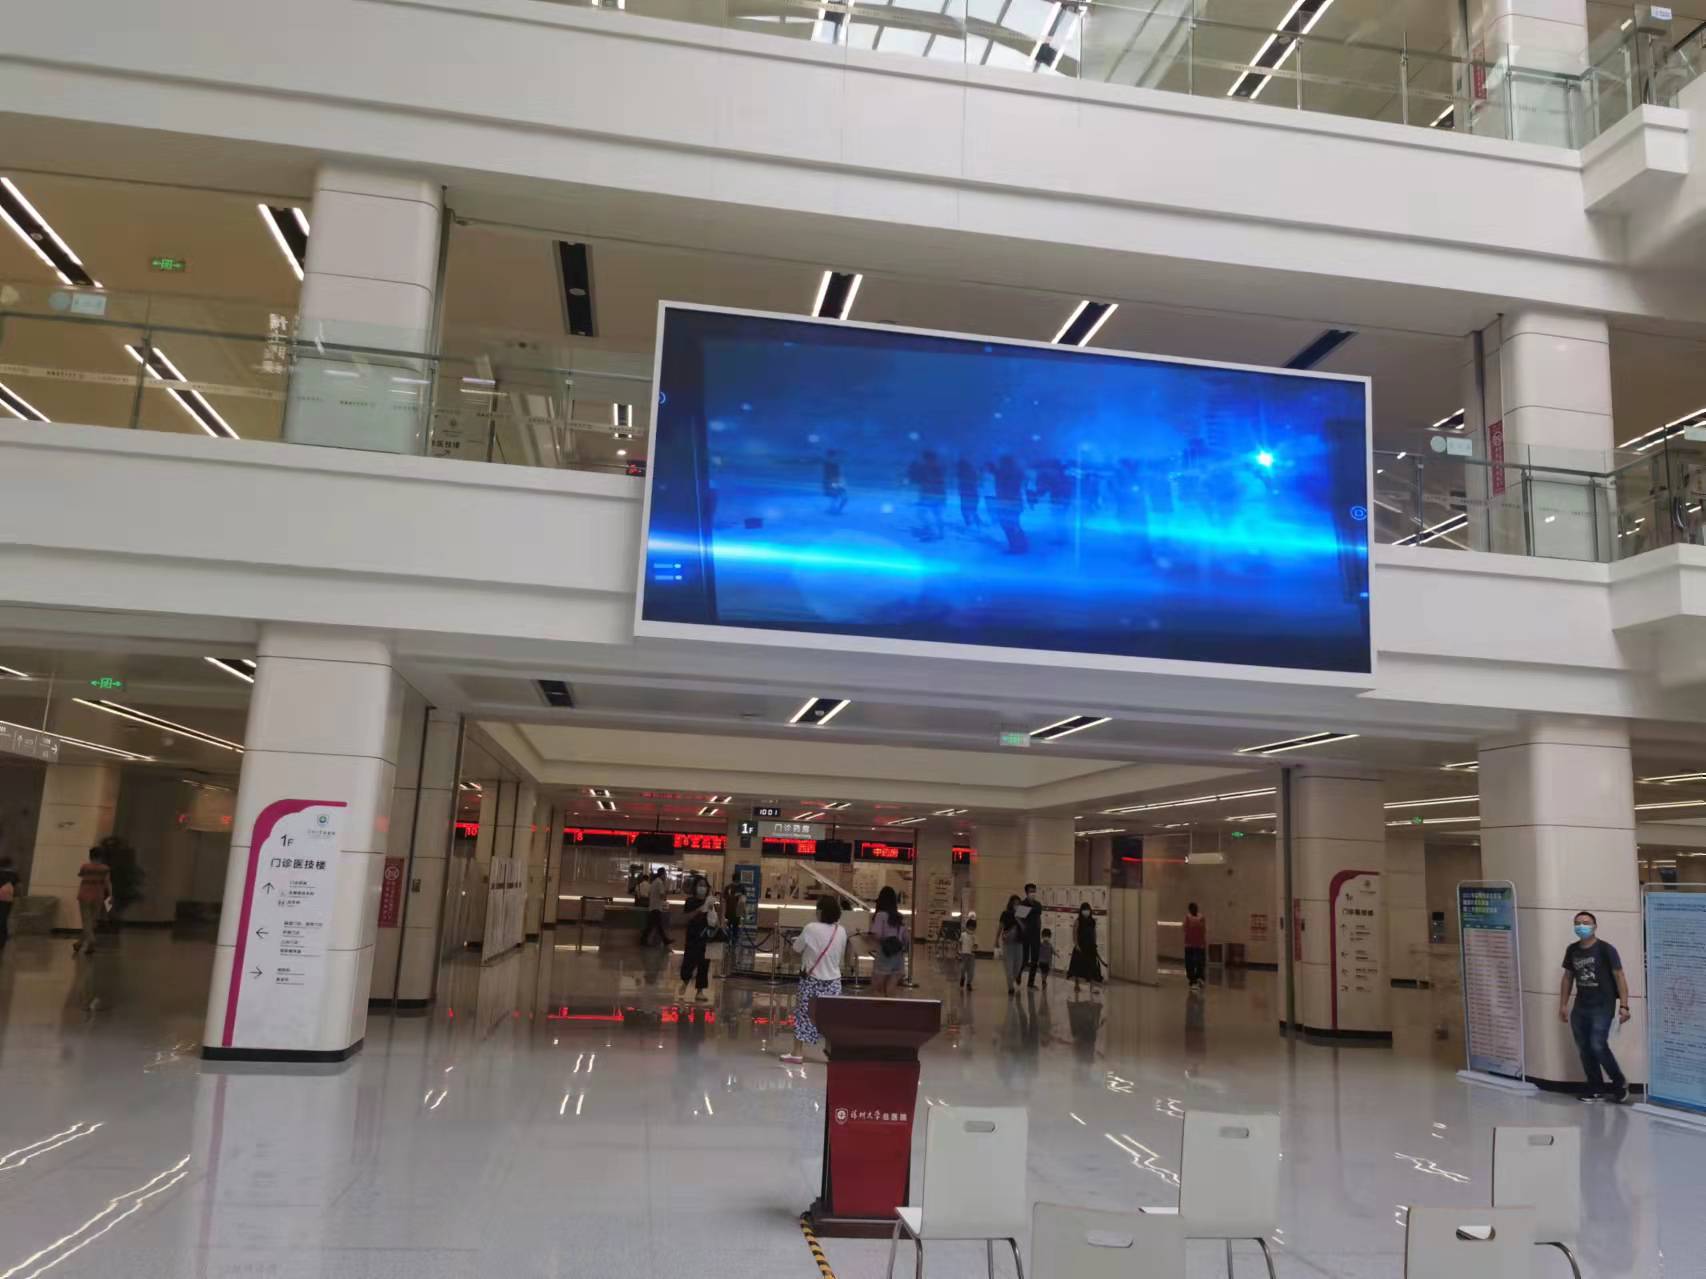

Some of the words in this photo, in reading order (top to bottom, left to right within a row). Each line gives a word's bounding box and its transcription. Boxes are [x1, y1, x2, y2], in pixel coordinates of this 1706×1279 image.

[741, 823, 753, 834] 1F
[774, 823, 810, 833] 门诊药房
[281, 834, 294, 847] 1F
[271, 858, 326, 869] 门诊医技楼
